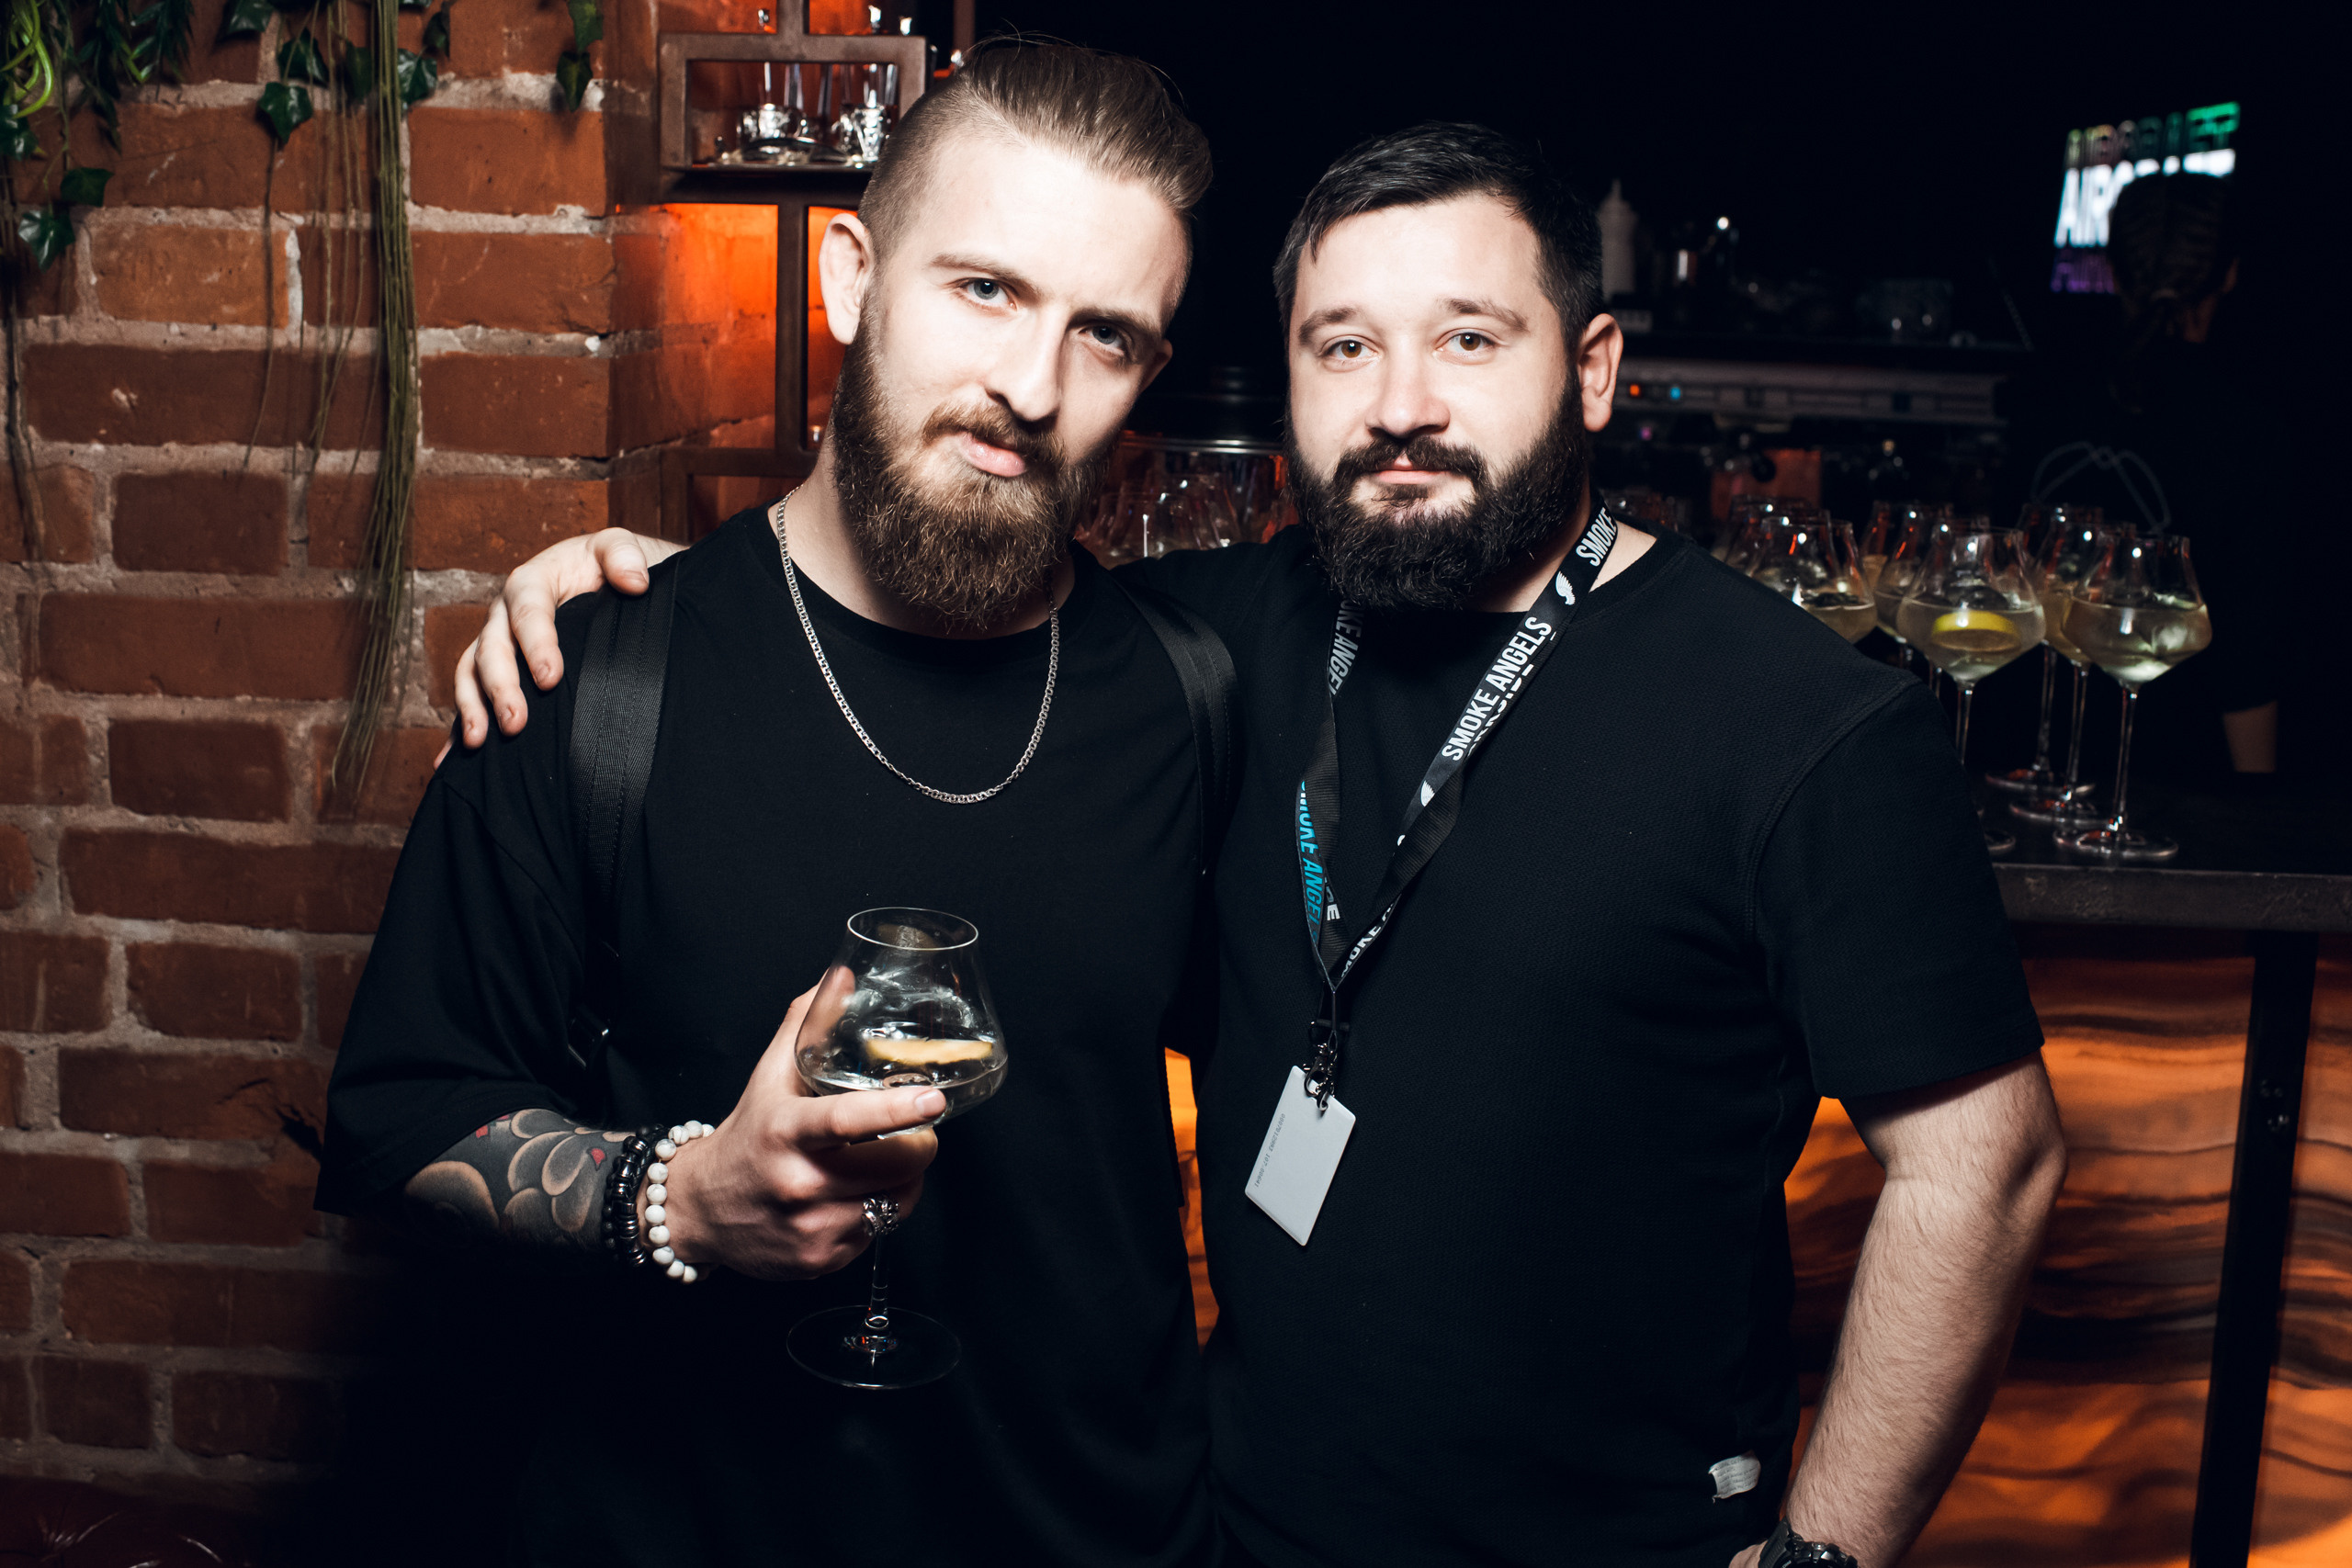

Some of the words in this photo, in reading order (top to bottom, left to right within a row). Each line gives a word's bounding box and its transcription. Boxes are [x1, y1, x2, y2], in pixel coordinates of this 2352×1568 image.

[1576, 507, 1616, 567] SMOKE
[1329, 632, 1359, 695] ANGE
[1442, 689, 1500, 761] SMOKE
[1486, 616, 1553, 692] ANGELS
